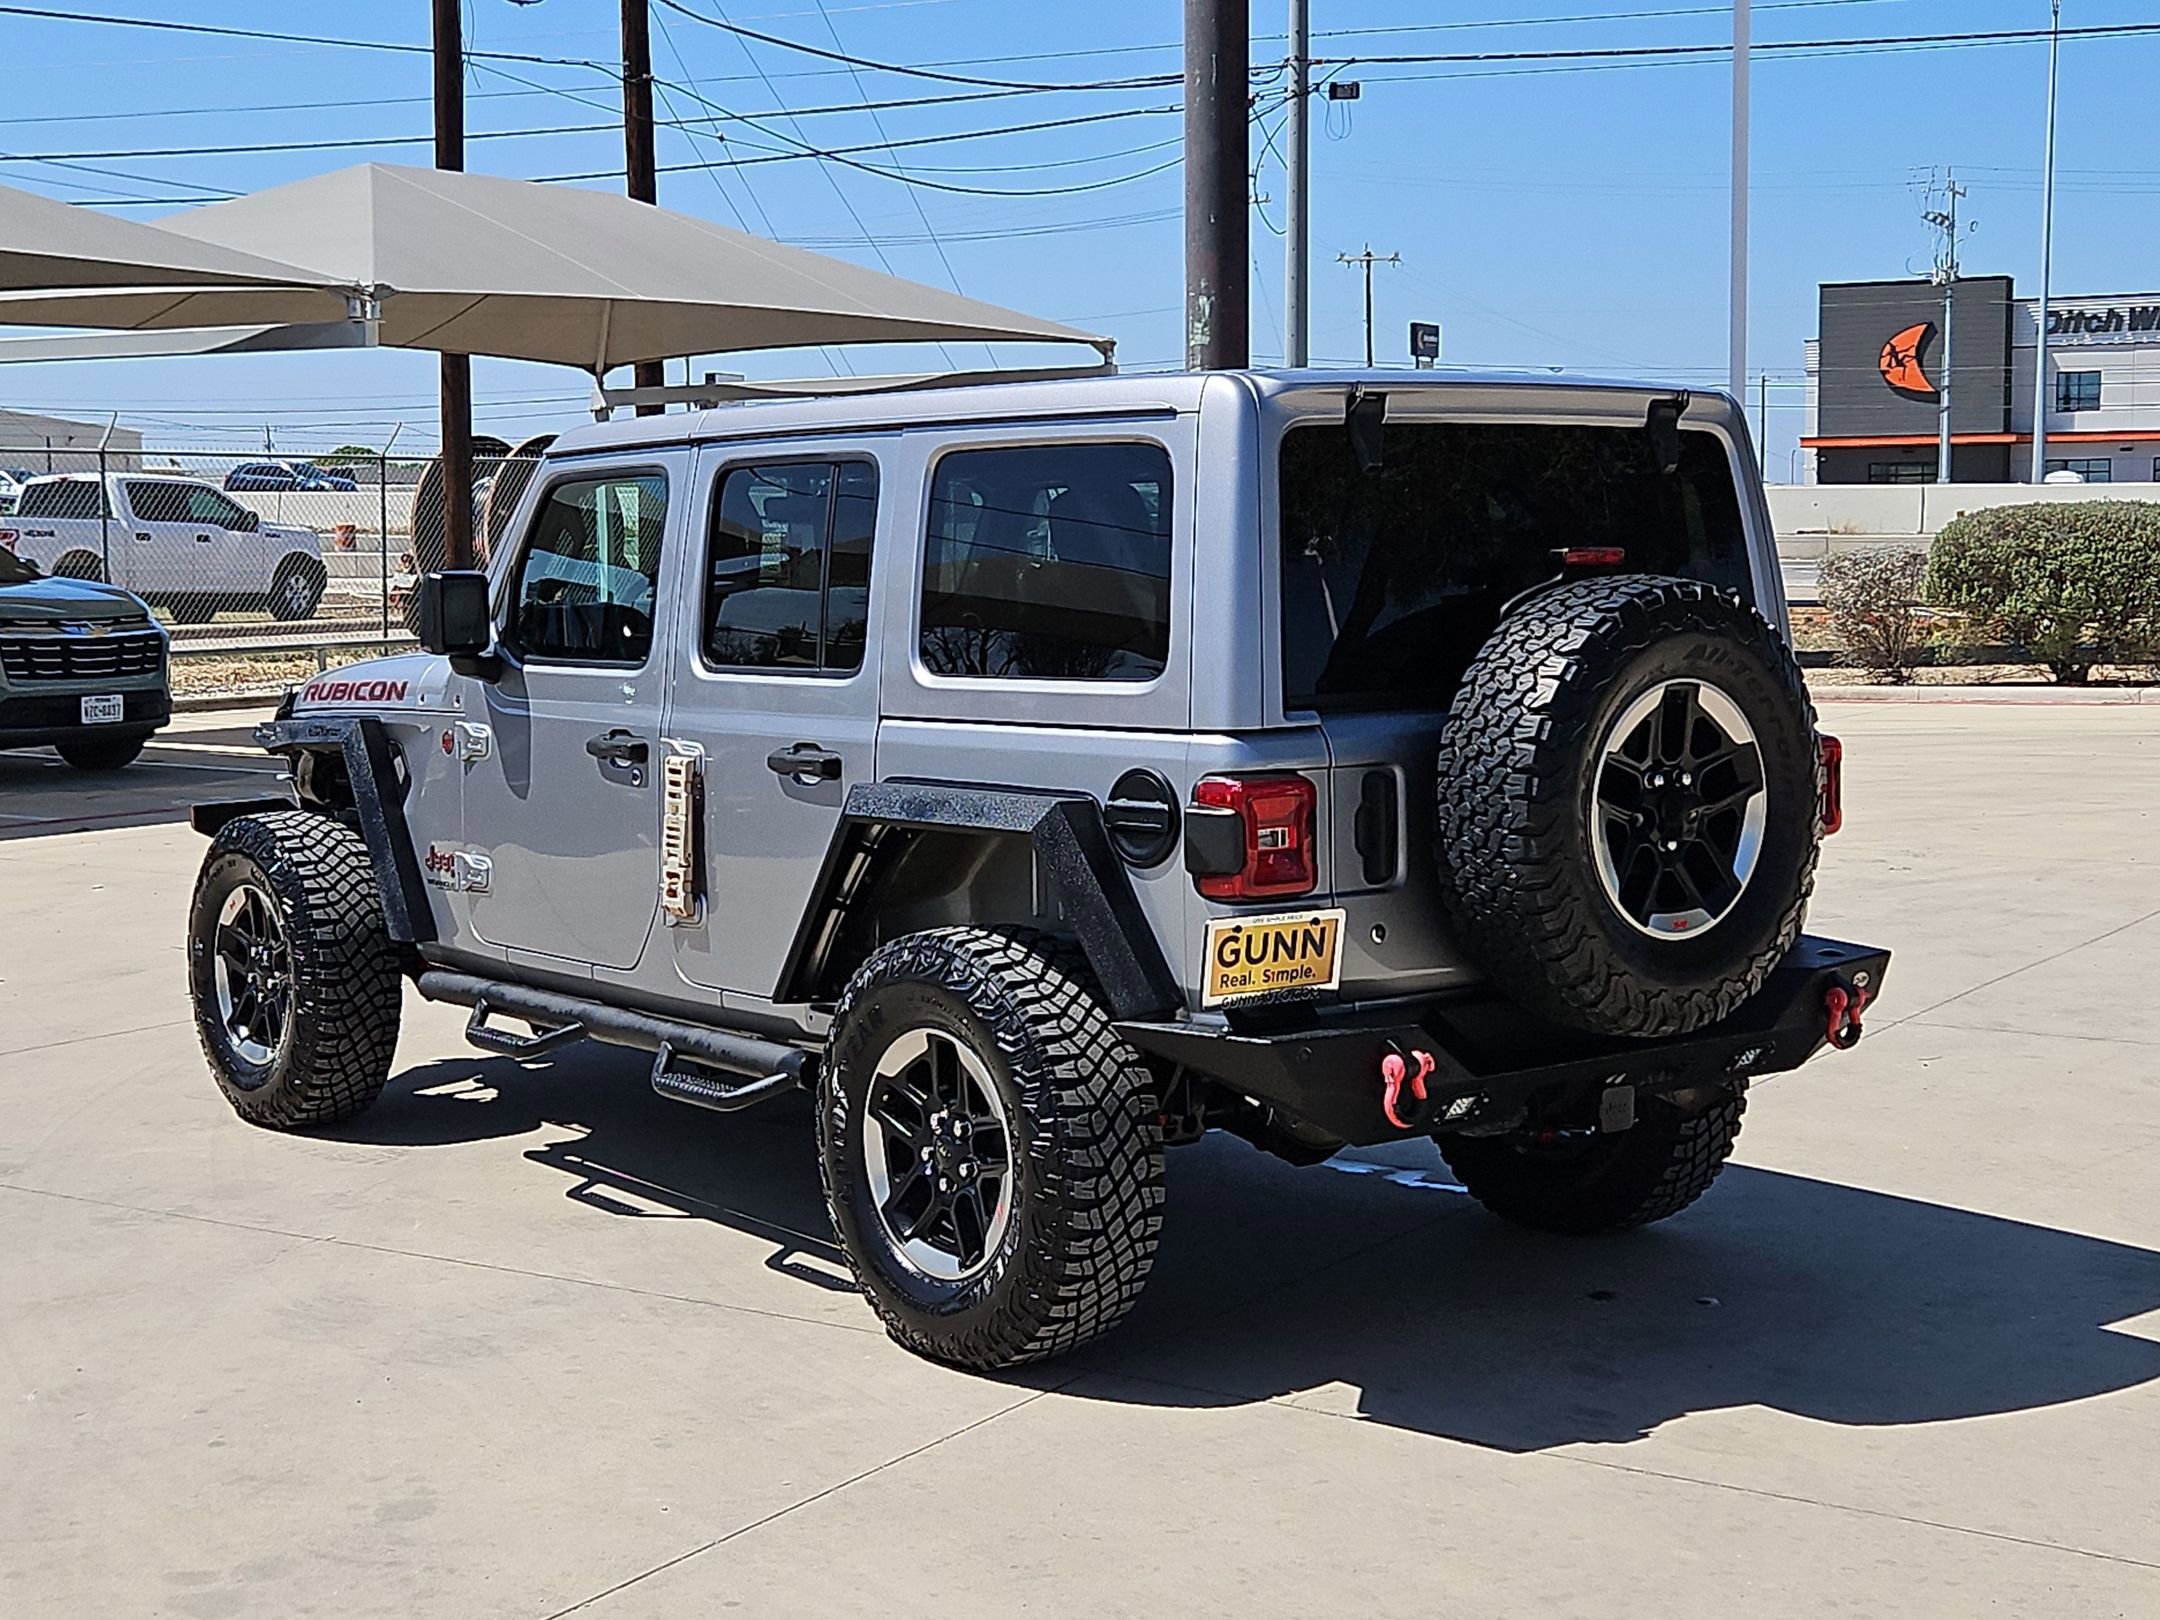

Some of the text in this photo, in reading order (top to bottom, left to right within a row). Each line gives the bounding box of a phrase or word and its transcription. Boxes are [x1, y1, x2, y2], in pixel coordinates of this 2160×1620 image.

[2129, 306, 2160, 331] W
[302, 680, 409, 702] RUBICON
[1217, 926, 1327, 968] GUNN
[1220, 970, 1256, 988] Real.
